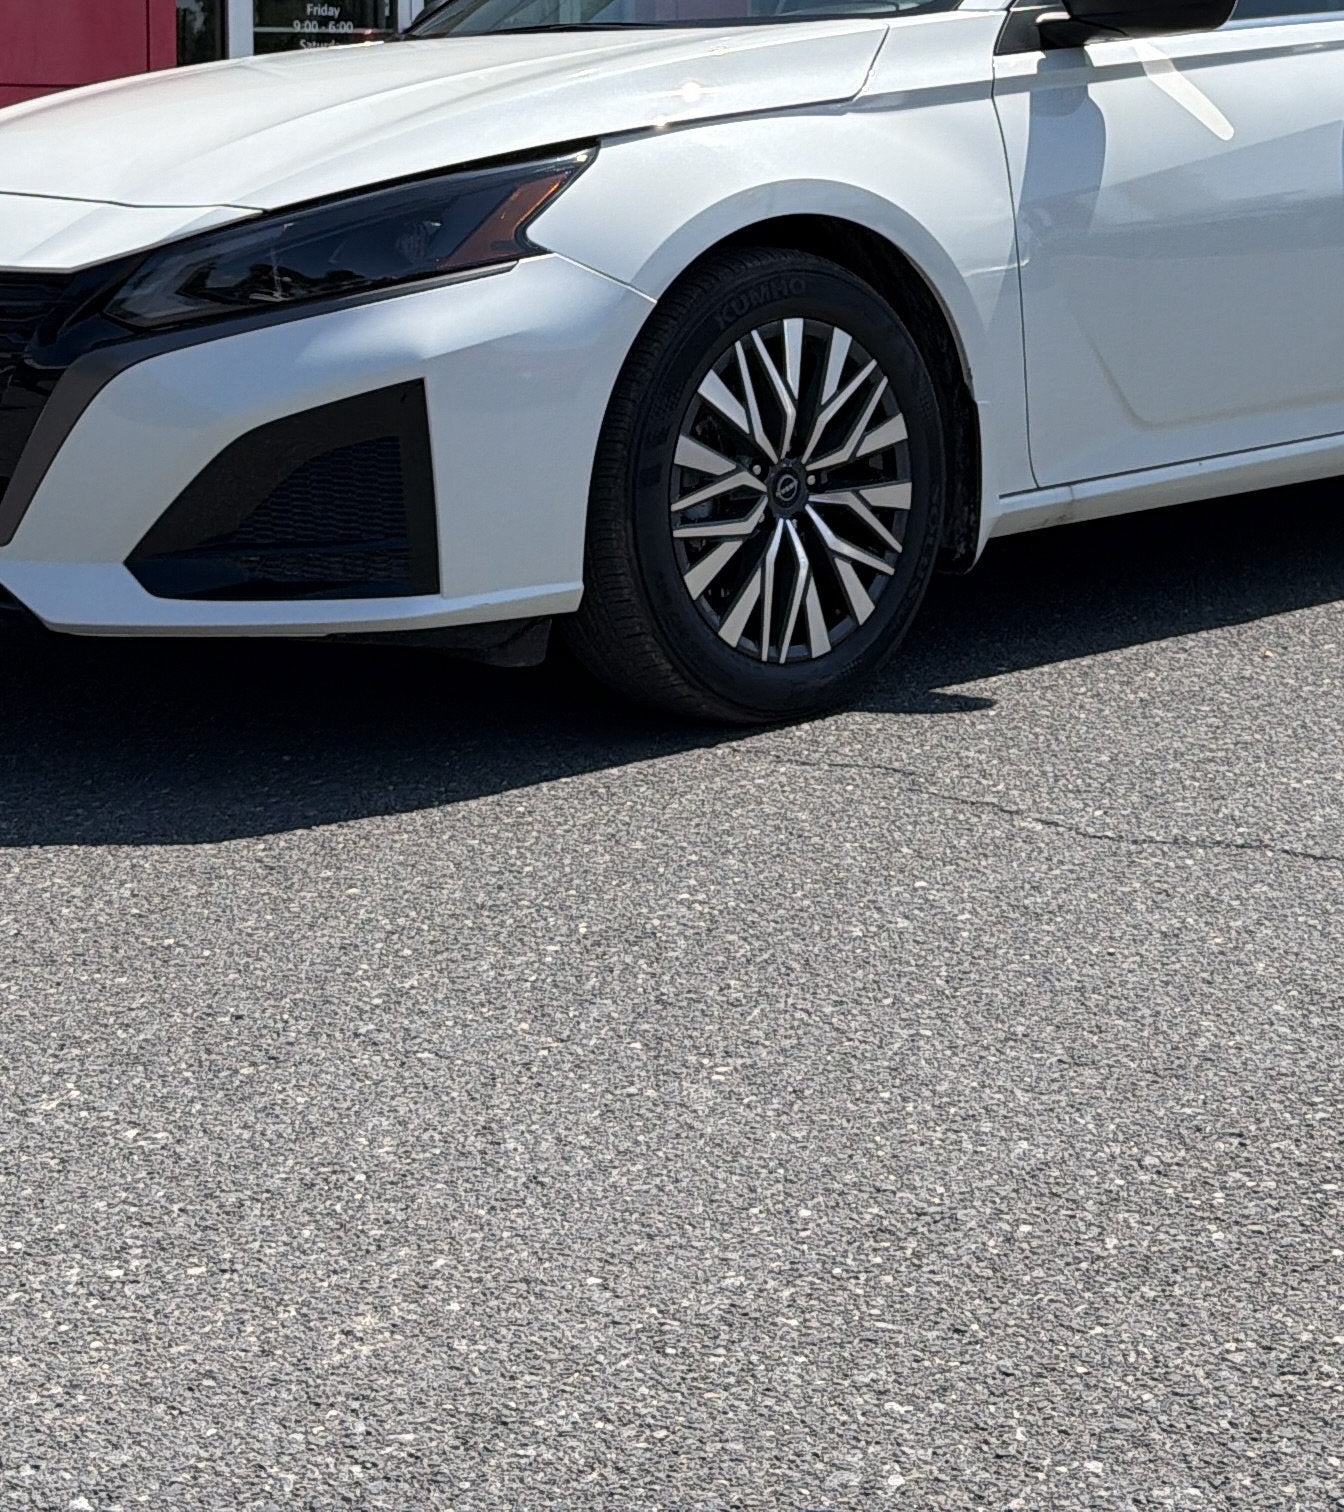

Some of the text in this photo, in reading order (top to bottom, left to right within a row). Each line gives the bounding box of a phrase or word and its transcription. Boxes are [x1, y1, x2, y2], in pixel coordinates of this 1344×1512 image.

[306, 3, 341, 18] Friday
[293, 20, 318, 33] 9:00
[328, 21, 353, 34] 6:00
[713, 278, 806, 330] KUMHO
